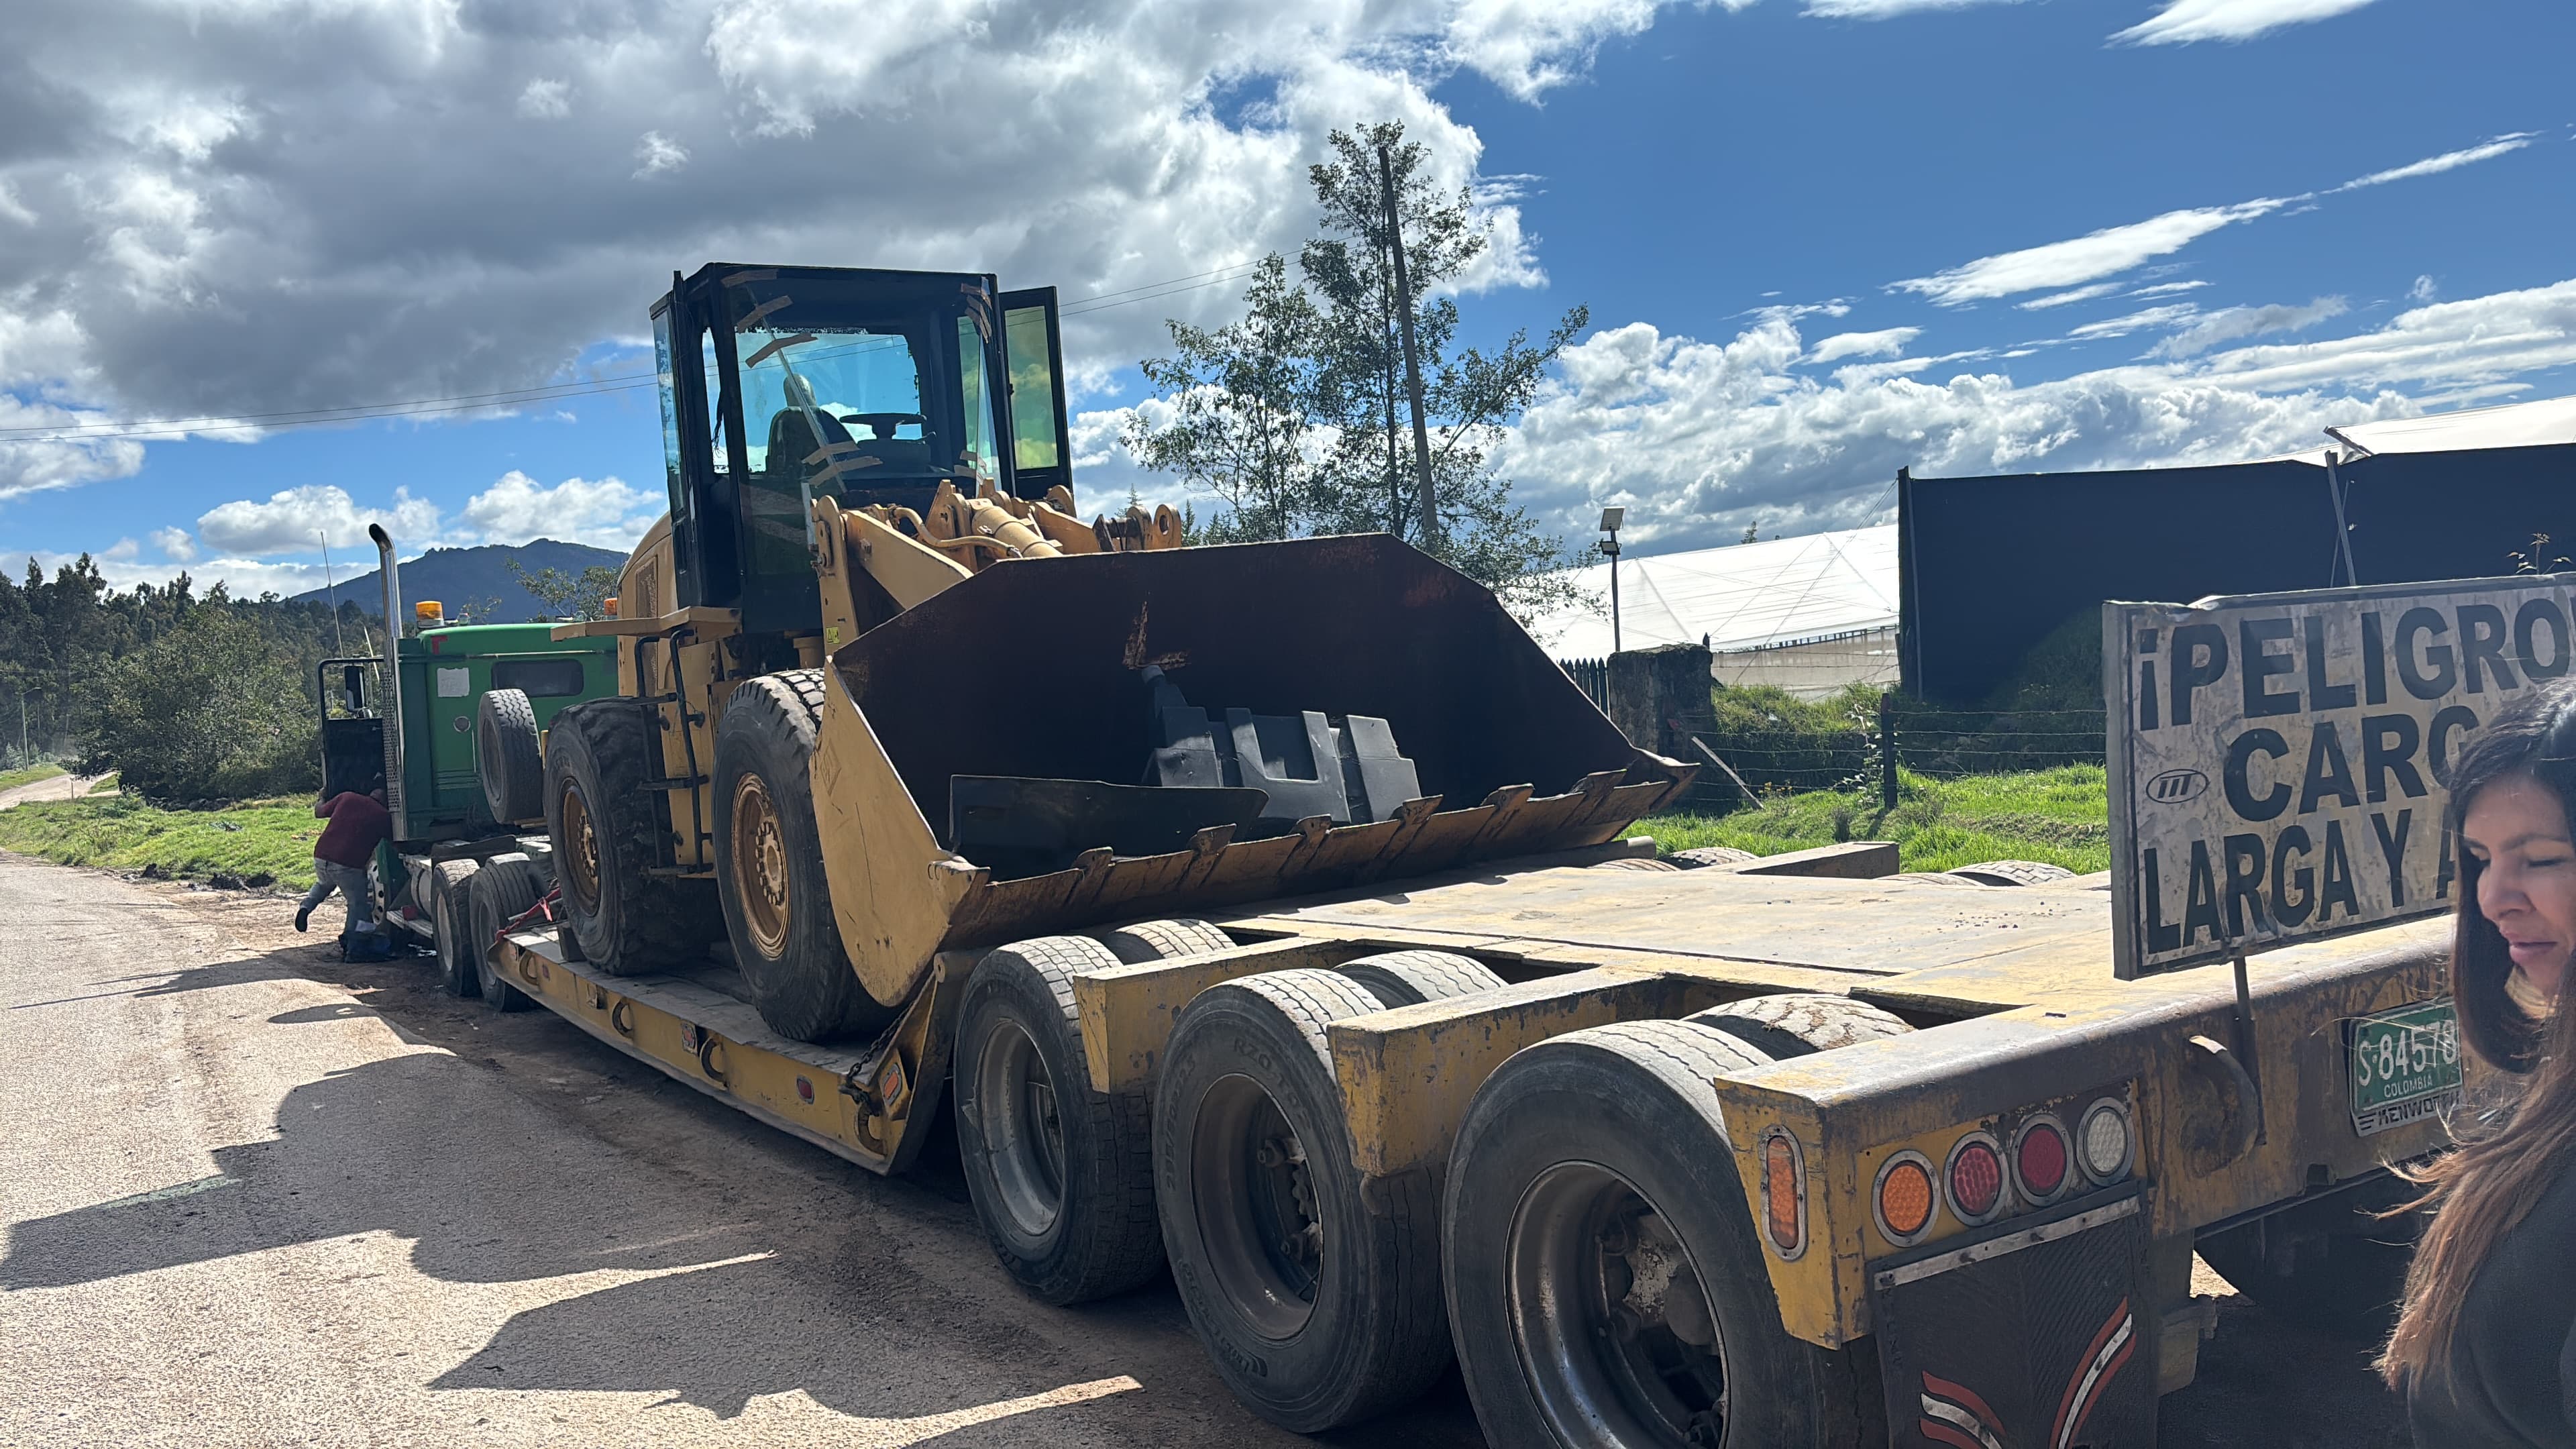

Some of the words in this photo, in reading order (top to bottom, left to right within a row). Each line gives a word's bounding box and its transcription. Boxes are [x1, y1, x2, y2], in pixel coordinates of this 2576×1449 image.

[2139, 598, 2576, 731] ¡PELIGRO
[2223, 705, 2479, 822] CARG
[2143, 820, 2359, 955] LARGA
[2370, 809, 2412, 908] Y
[2383, 1075, 2433, 1098] COLOMBIA
